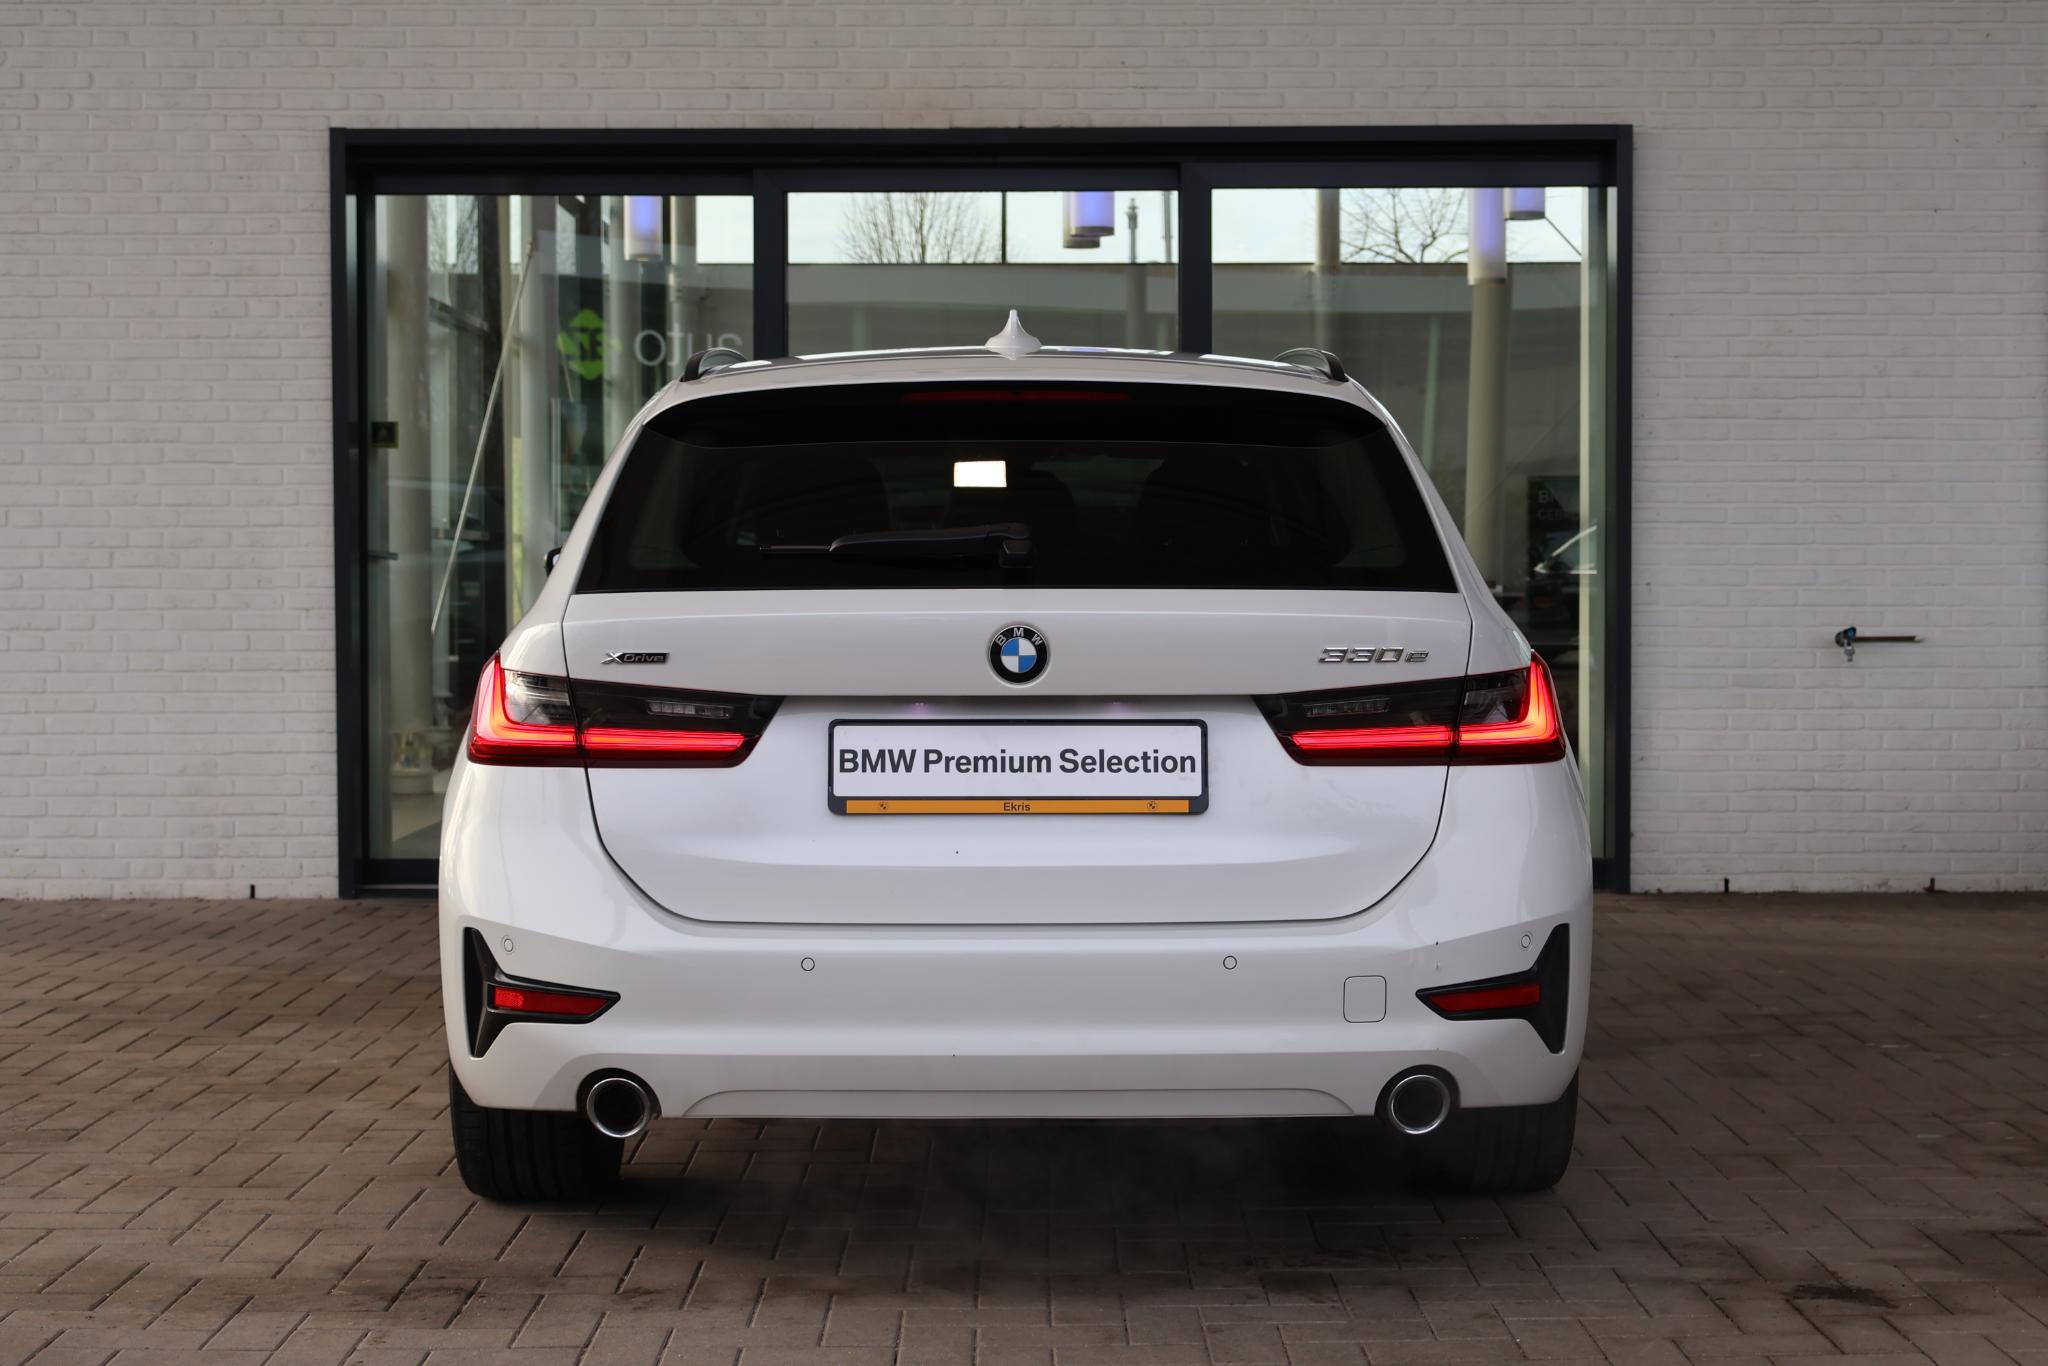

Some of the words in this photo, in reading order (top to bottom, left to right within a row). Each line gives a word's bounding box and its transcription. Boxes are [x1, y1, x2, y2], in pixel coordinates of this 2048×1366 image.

[994, 627, 1043, 646] BMW
[838, 748, 917, 774] BMW
[923, 748, 1052, 774] Premium
[1058, 748, 1197, 774] Selection
[1003, 802, 1031, 811] Ekris
